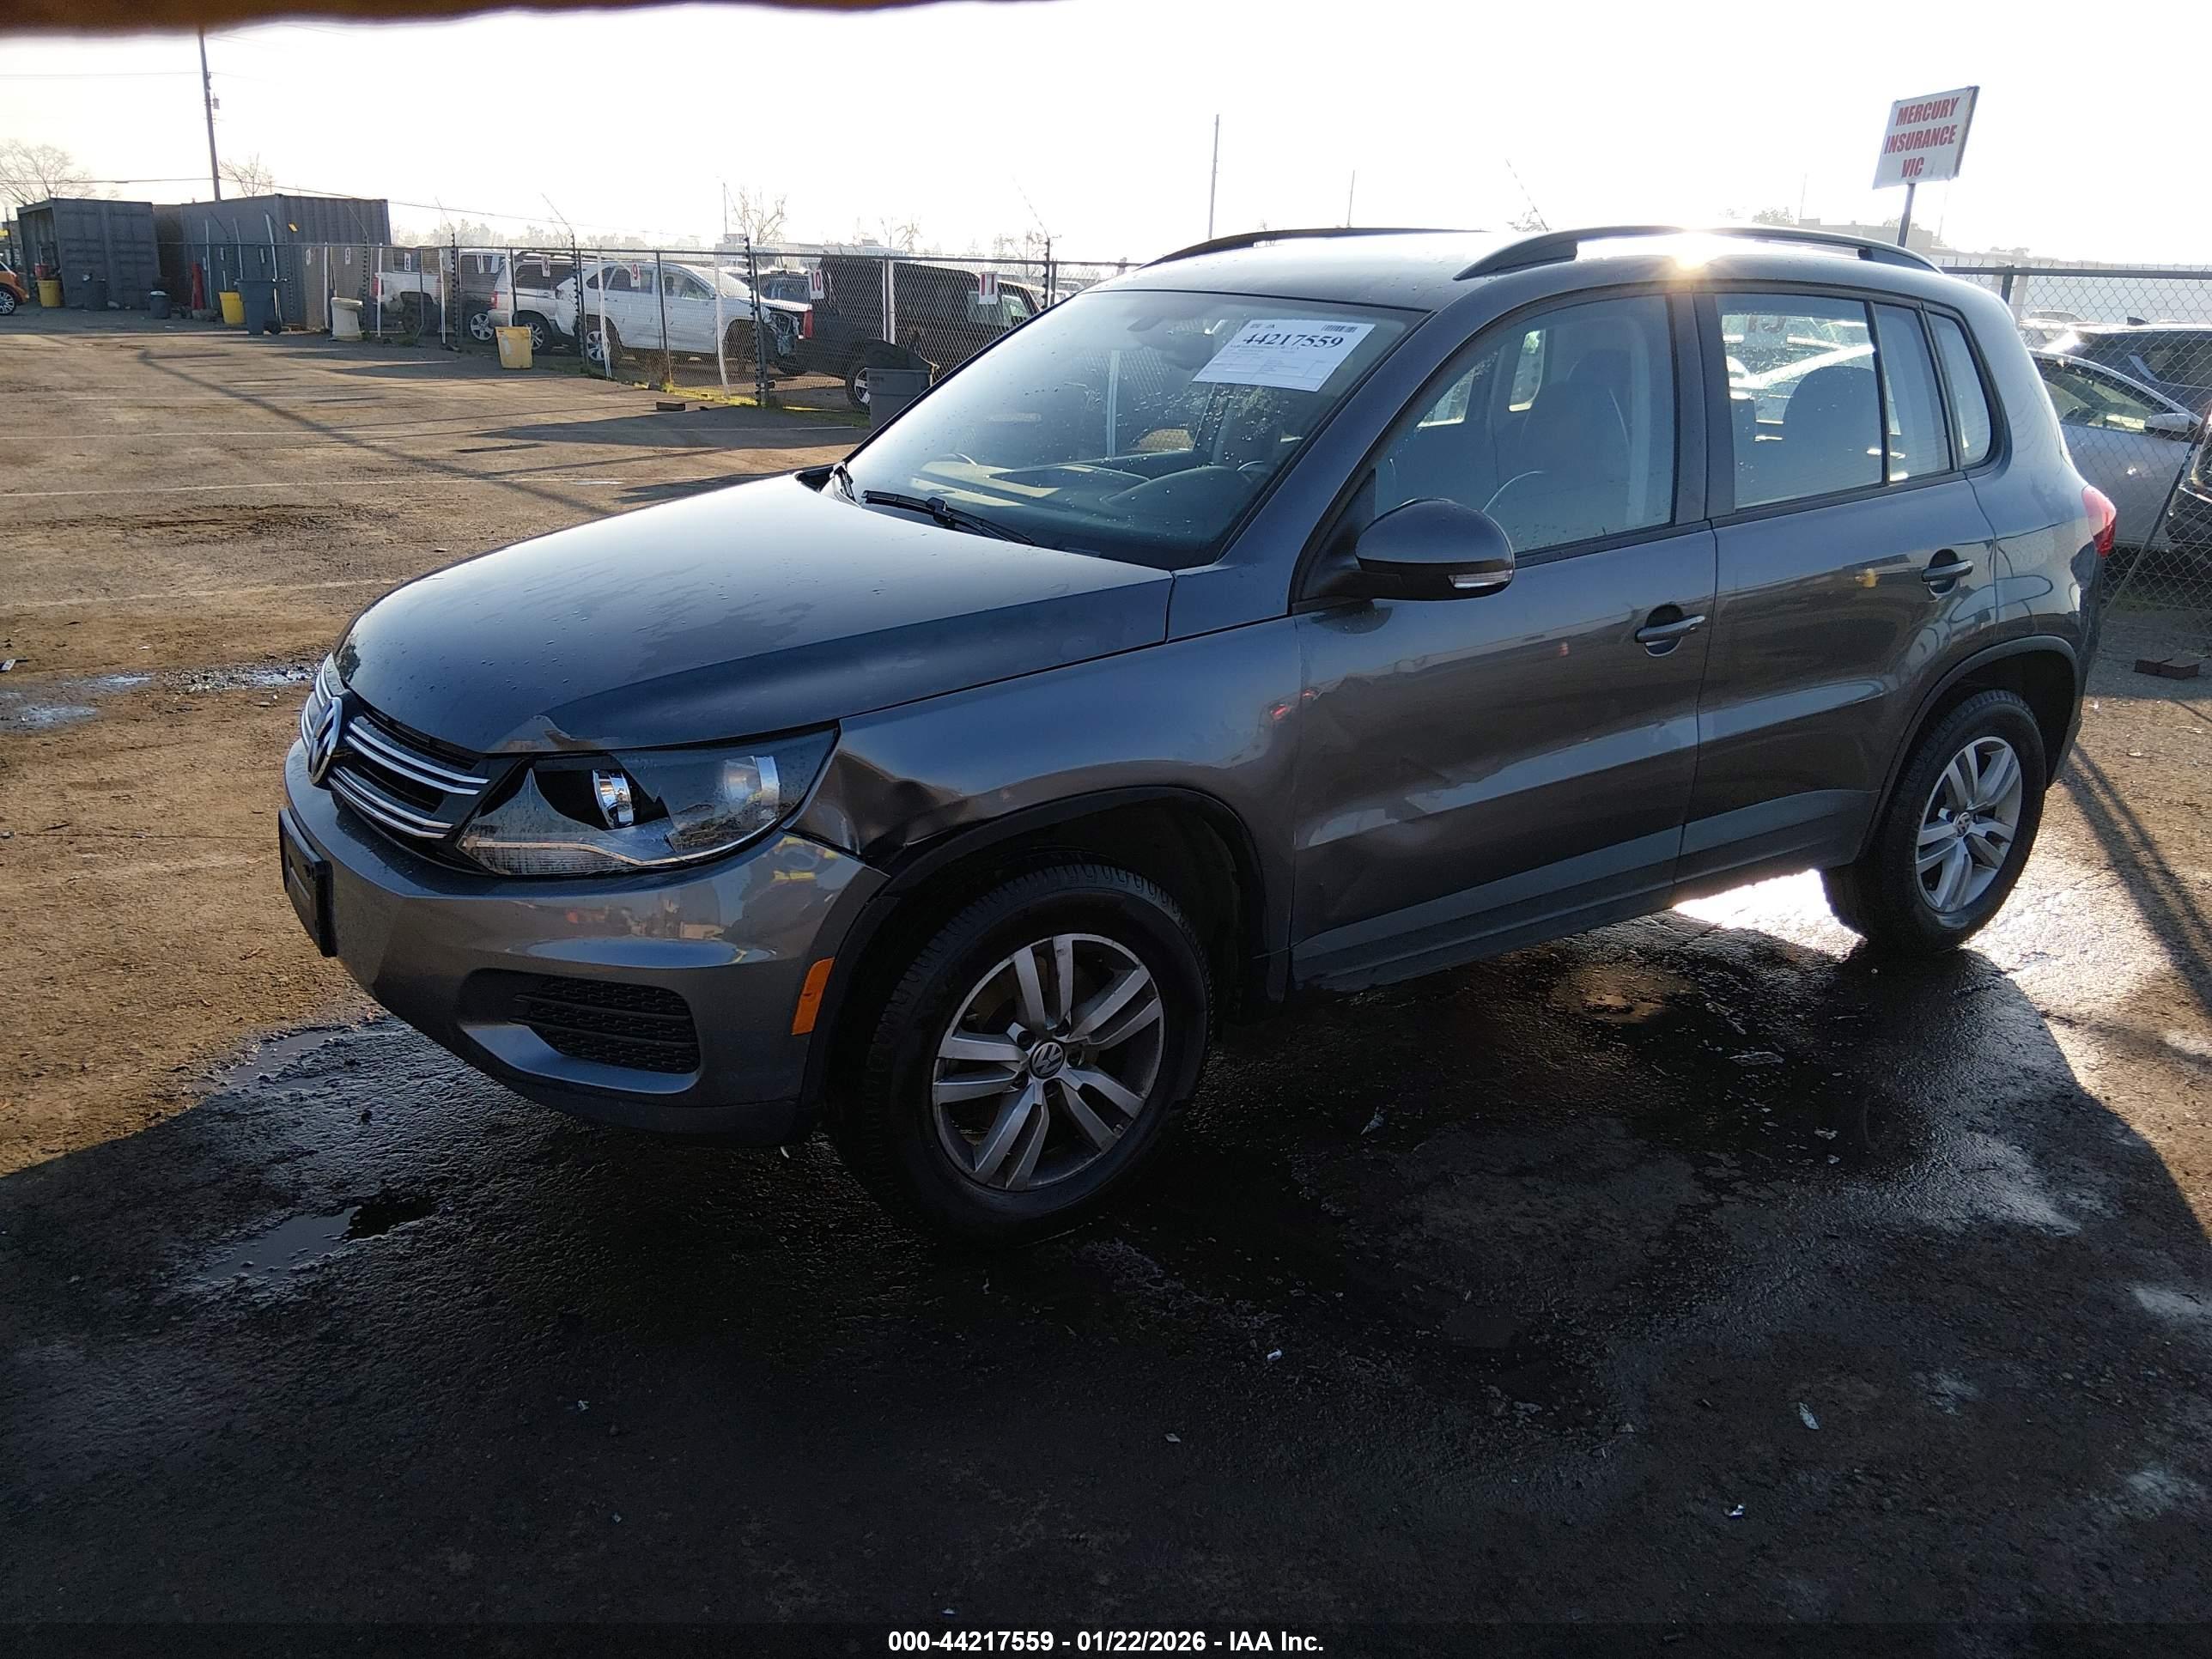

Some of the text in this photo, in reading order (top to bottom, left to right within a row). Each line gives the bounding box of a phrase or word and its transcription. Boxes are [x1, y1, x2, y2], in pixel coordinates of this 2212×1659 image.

[1896, 97, 1960, 125] MERCURY
[1884, 125, 1958, 154] INSURANCE
[1901, 156, 1925, 179] VIC
[632, 264, 640, 281] 9
[811, 270, 822, 292] 10
[981, 274, 995, 296] 11
[1243, 333, 1344, 349] 44217559
